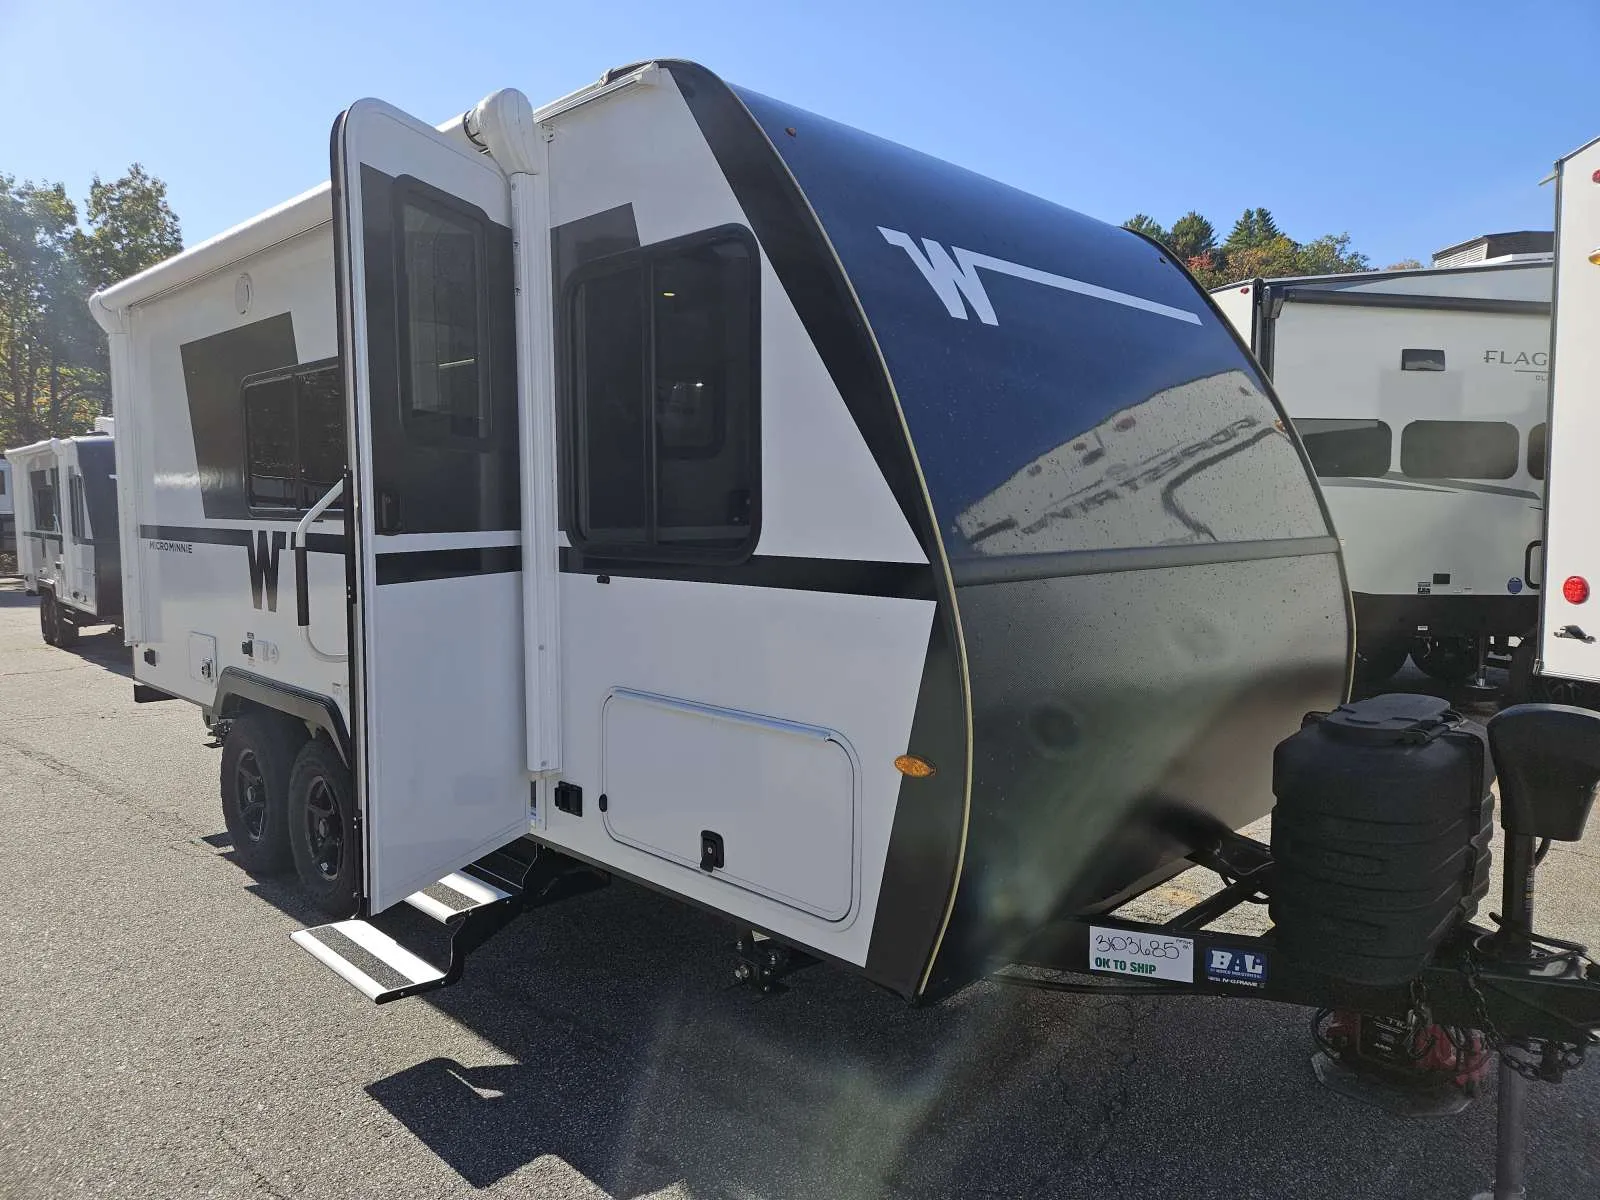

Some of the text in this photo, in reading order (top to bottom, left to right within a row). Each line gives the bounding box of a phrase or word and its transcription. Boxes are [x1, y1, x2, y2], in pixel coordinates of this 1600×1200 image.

[149, 540, 193, 554] MICROMINNIE
[247, 529, 287, 613] W
[1095, 956, 1157, 975] OK TO SHIP
[1211, 949, 1263, 974] BAL
